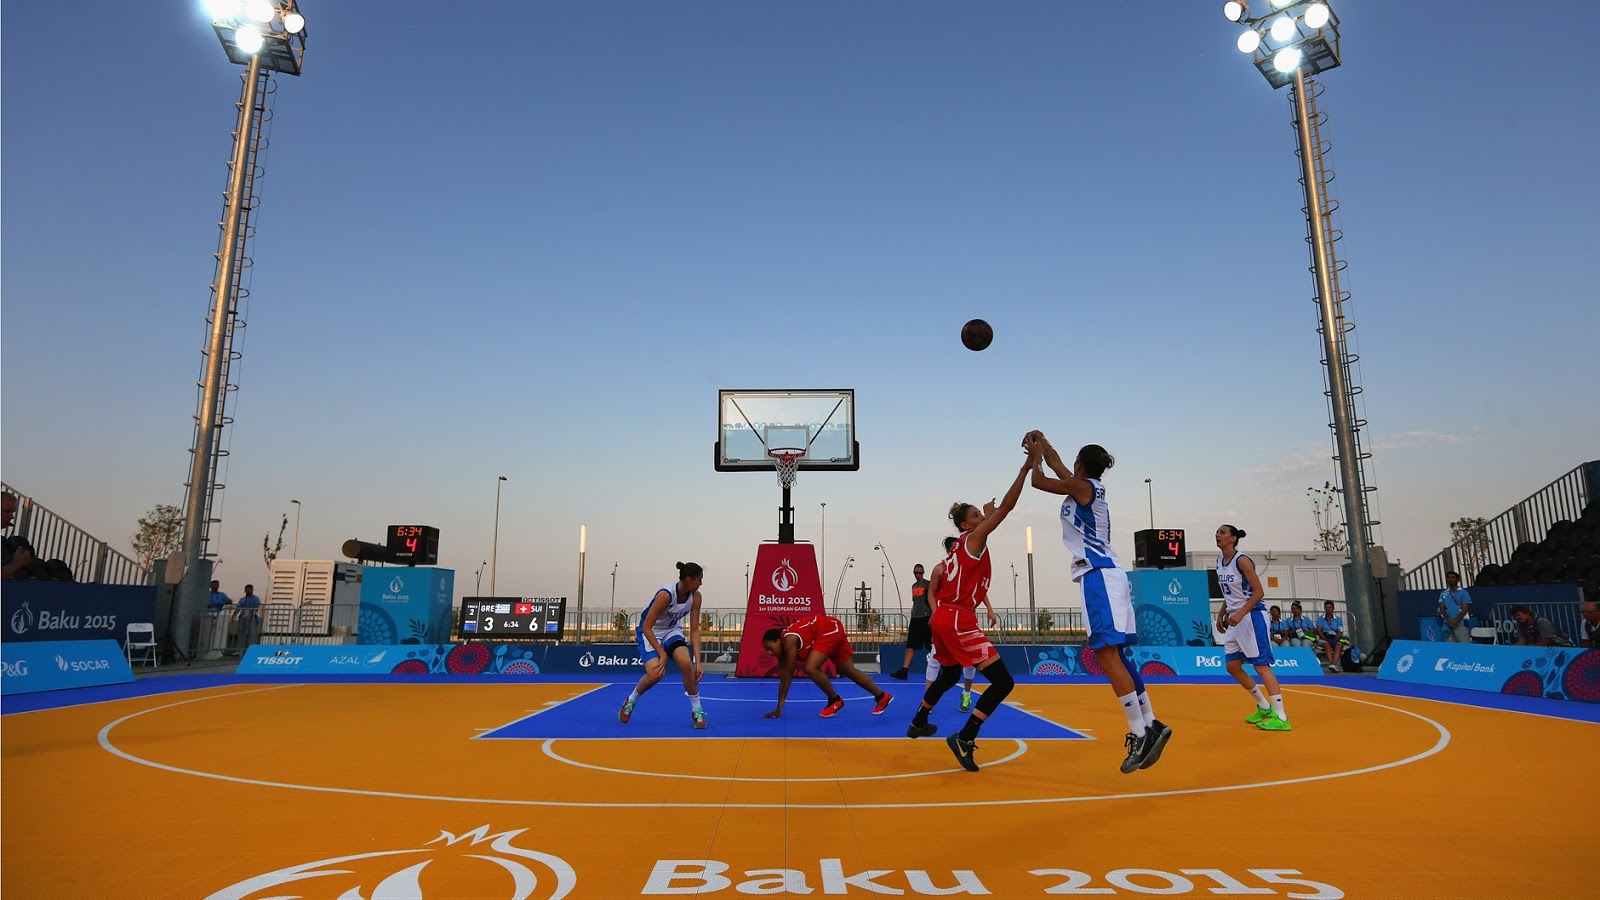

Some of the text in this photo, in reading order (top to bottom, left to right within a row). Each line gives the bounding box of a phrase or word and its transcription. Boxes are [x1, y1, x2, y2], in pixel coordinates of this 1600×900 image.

[397, 527, 422, 536] 6:34
[1158, 530, 1183, 540] 6:34
[406, 538, 418, 552] 4
[1168, 541, 1179, 556] 4
[758, 594, 811, 606] Baku 2015
[469, 608, 475, 616] 2
[481, 605, 495, 613] GRE
[531, 605, 542, 613] SUI
[37, 610, 116, 631] Baku 2015
[483, 617, 539, 632] 3 6:34 6
[71, 659, 110, 672] SOCAR
[257, 656, 303, 665] TISSOT
[329, 656, 360, 665] AZAL
[597, 656, 628, 666] Baku
[1196, 656, 1222, 667] P&G
[1446, 661, 1496, 673] Kapital Bank
[640, 858, 1345, 900] Baku 2015
